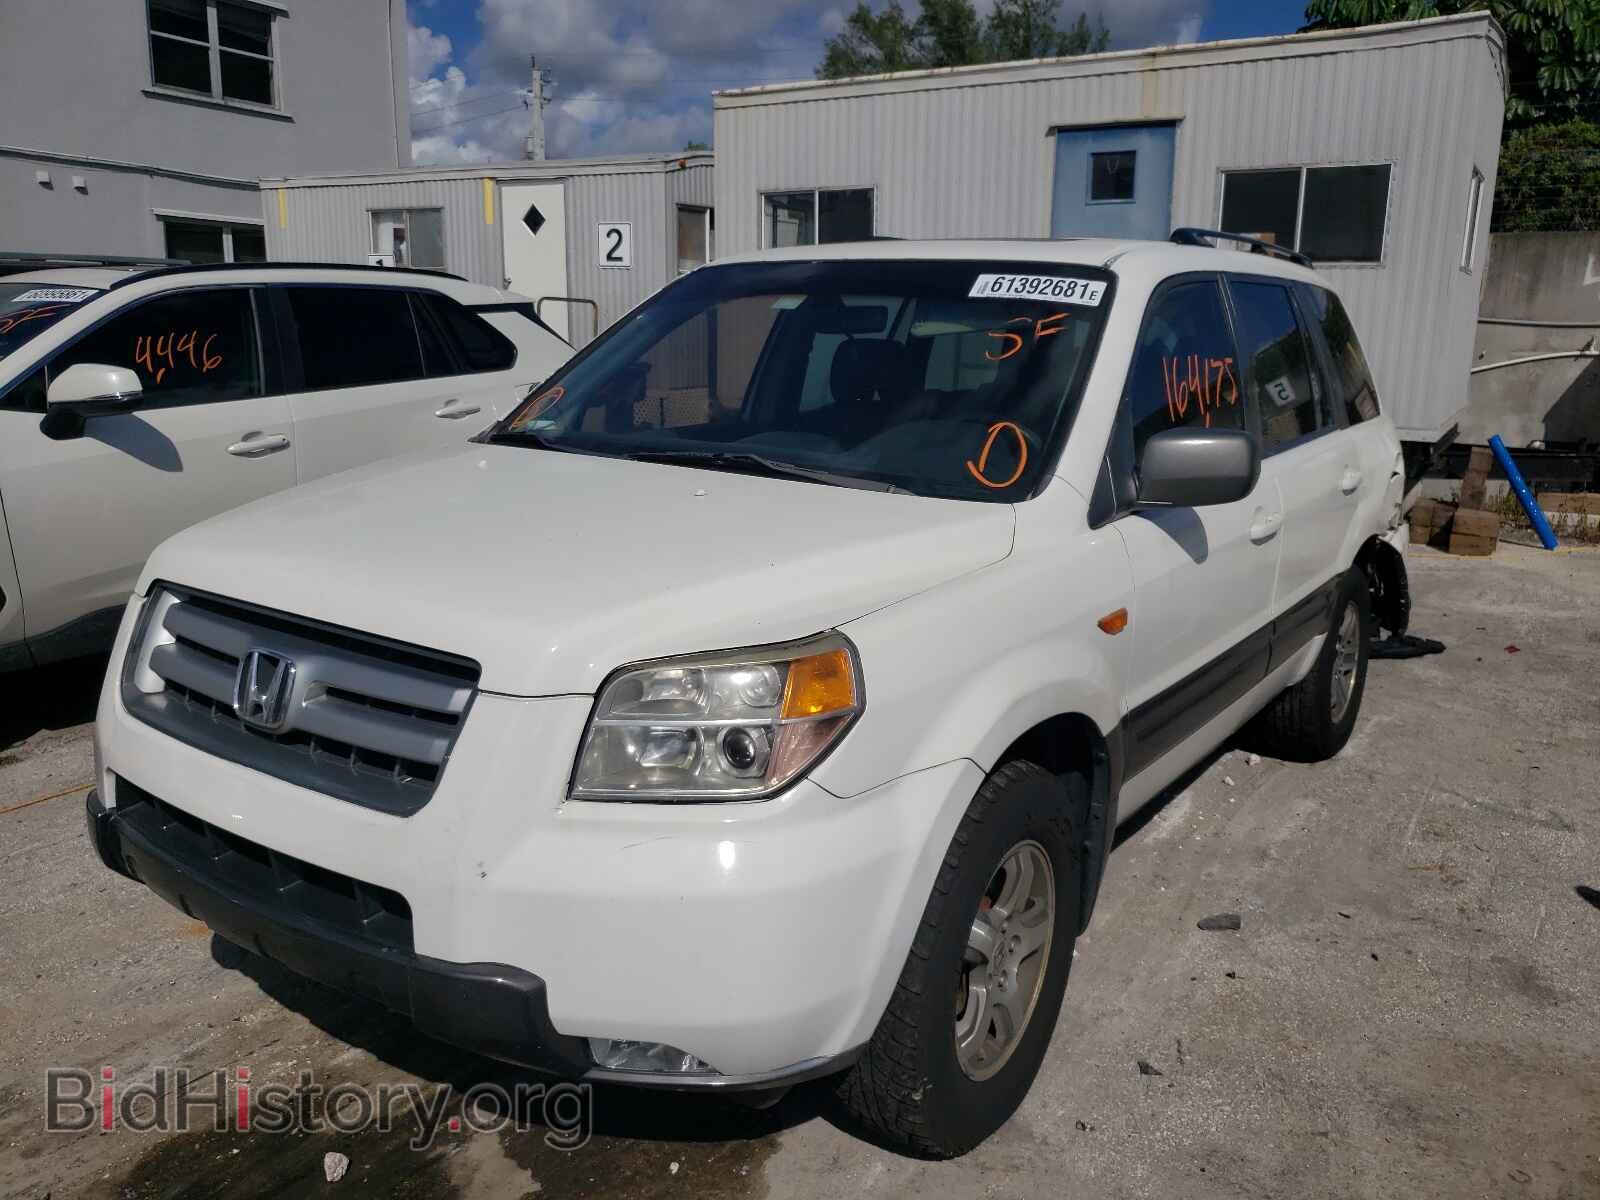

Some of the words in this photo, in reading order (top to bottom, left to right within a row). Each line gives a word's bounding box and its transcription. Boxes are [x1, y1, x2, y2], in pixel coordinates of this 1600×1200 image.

[606, 228, 623, 262] 2
[990, 276, 1091, 300] 61392681
[1089, 290, 1099, 301] E
